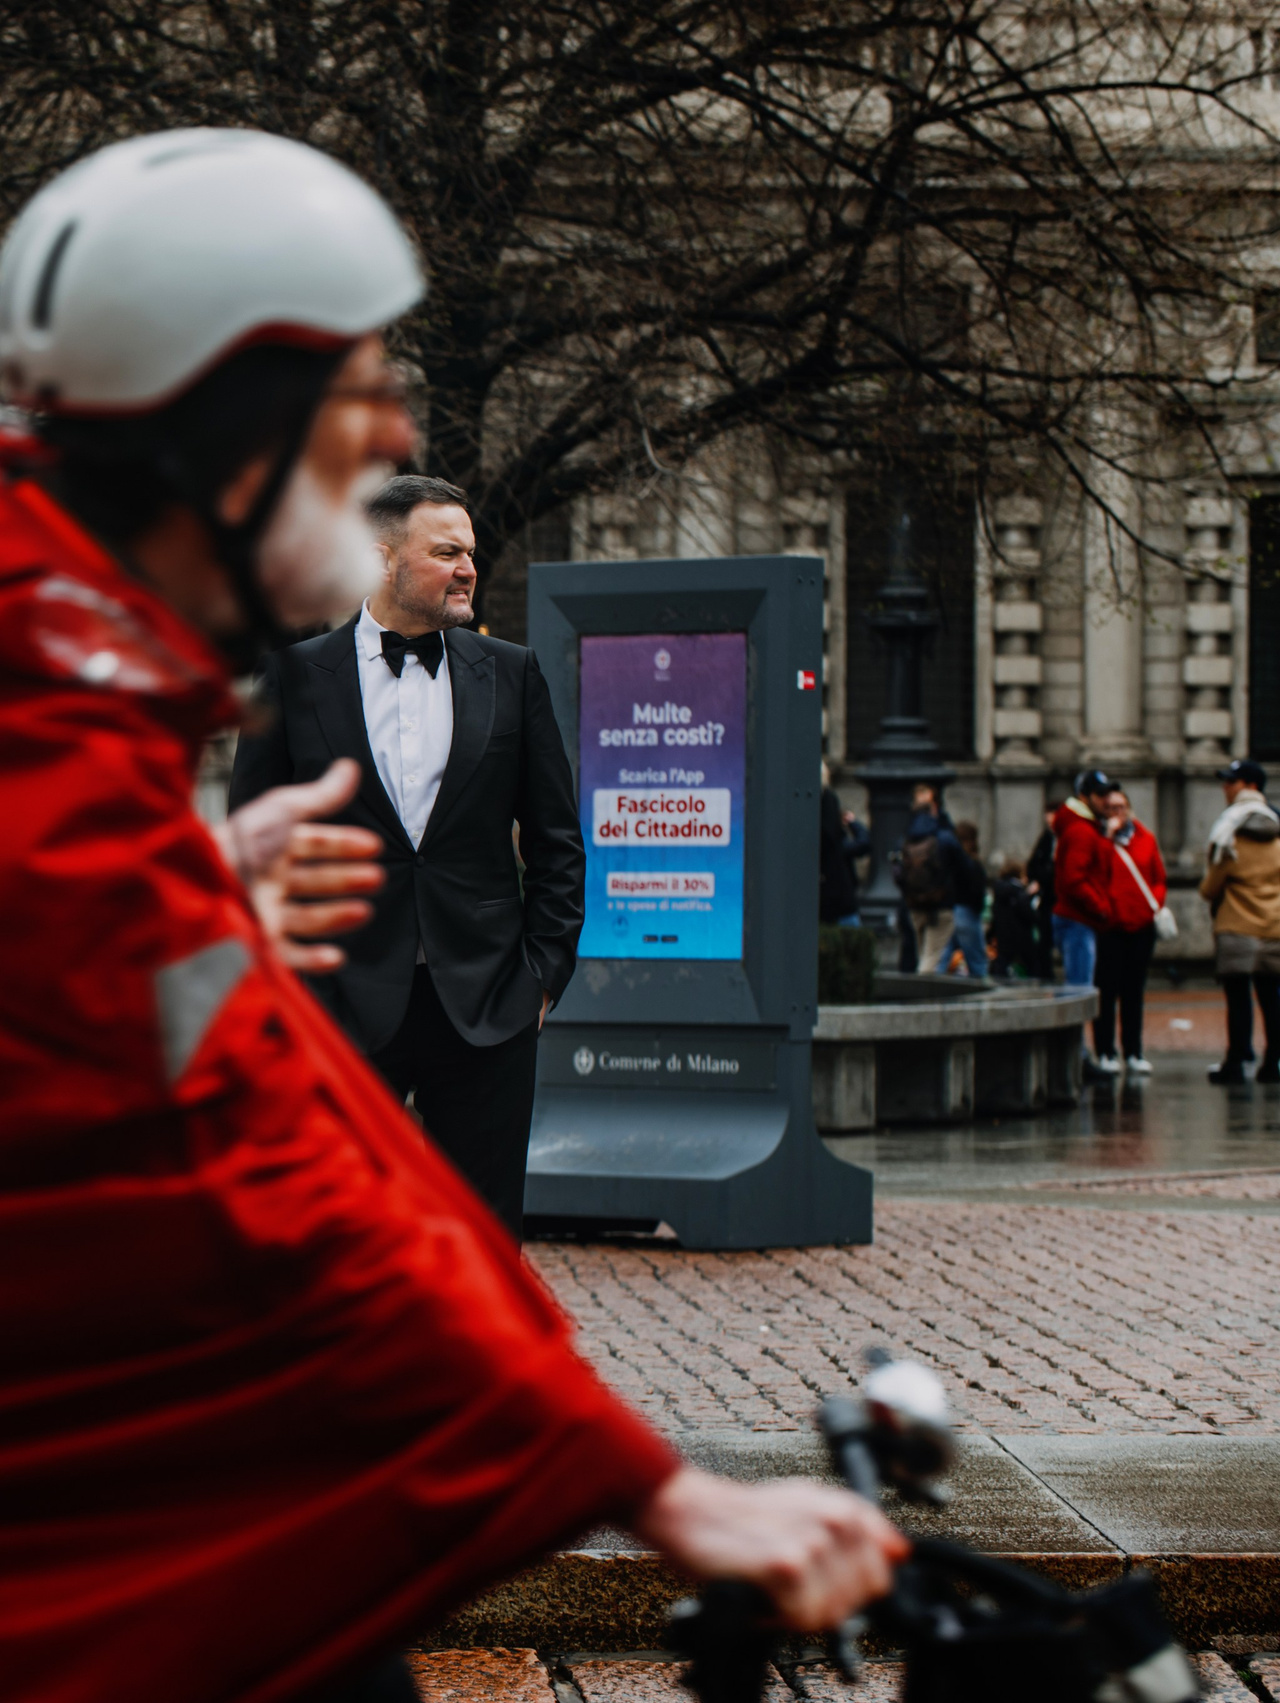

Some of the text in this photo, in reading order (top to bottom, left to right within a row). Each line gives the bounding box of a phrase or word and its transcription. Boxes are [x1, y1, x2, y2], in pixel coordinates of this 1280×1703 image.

[633, 701, 692, 724] Multe
[599, 721, 725, 747] senza costi?
[619, 767, 705, 786] Scarica l'App
[617, 794, 706, 813] Fascicolo
[599, 818, 723, 838] del Cittadino
[611, 878, 709, 892] Risparmi il 30%
[666, 1053, 681, 1073] di
[687, 1053, 739, 1074] Milano
